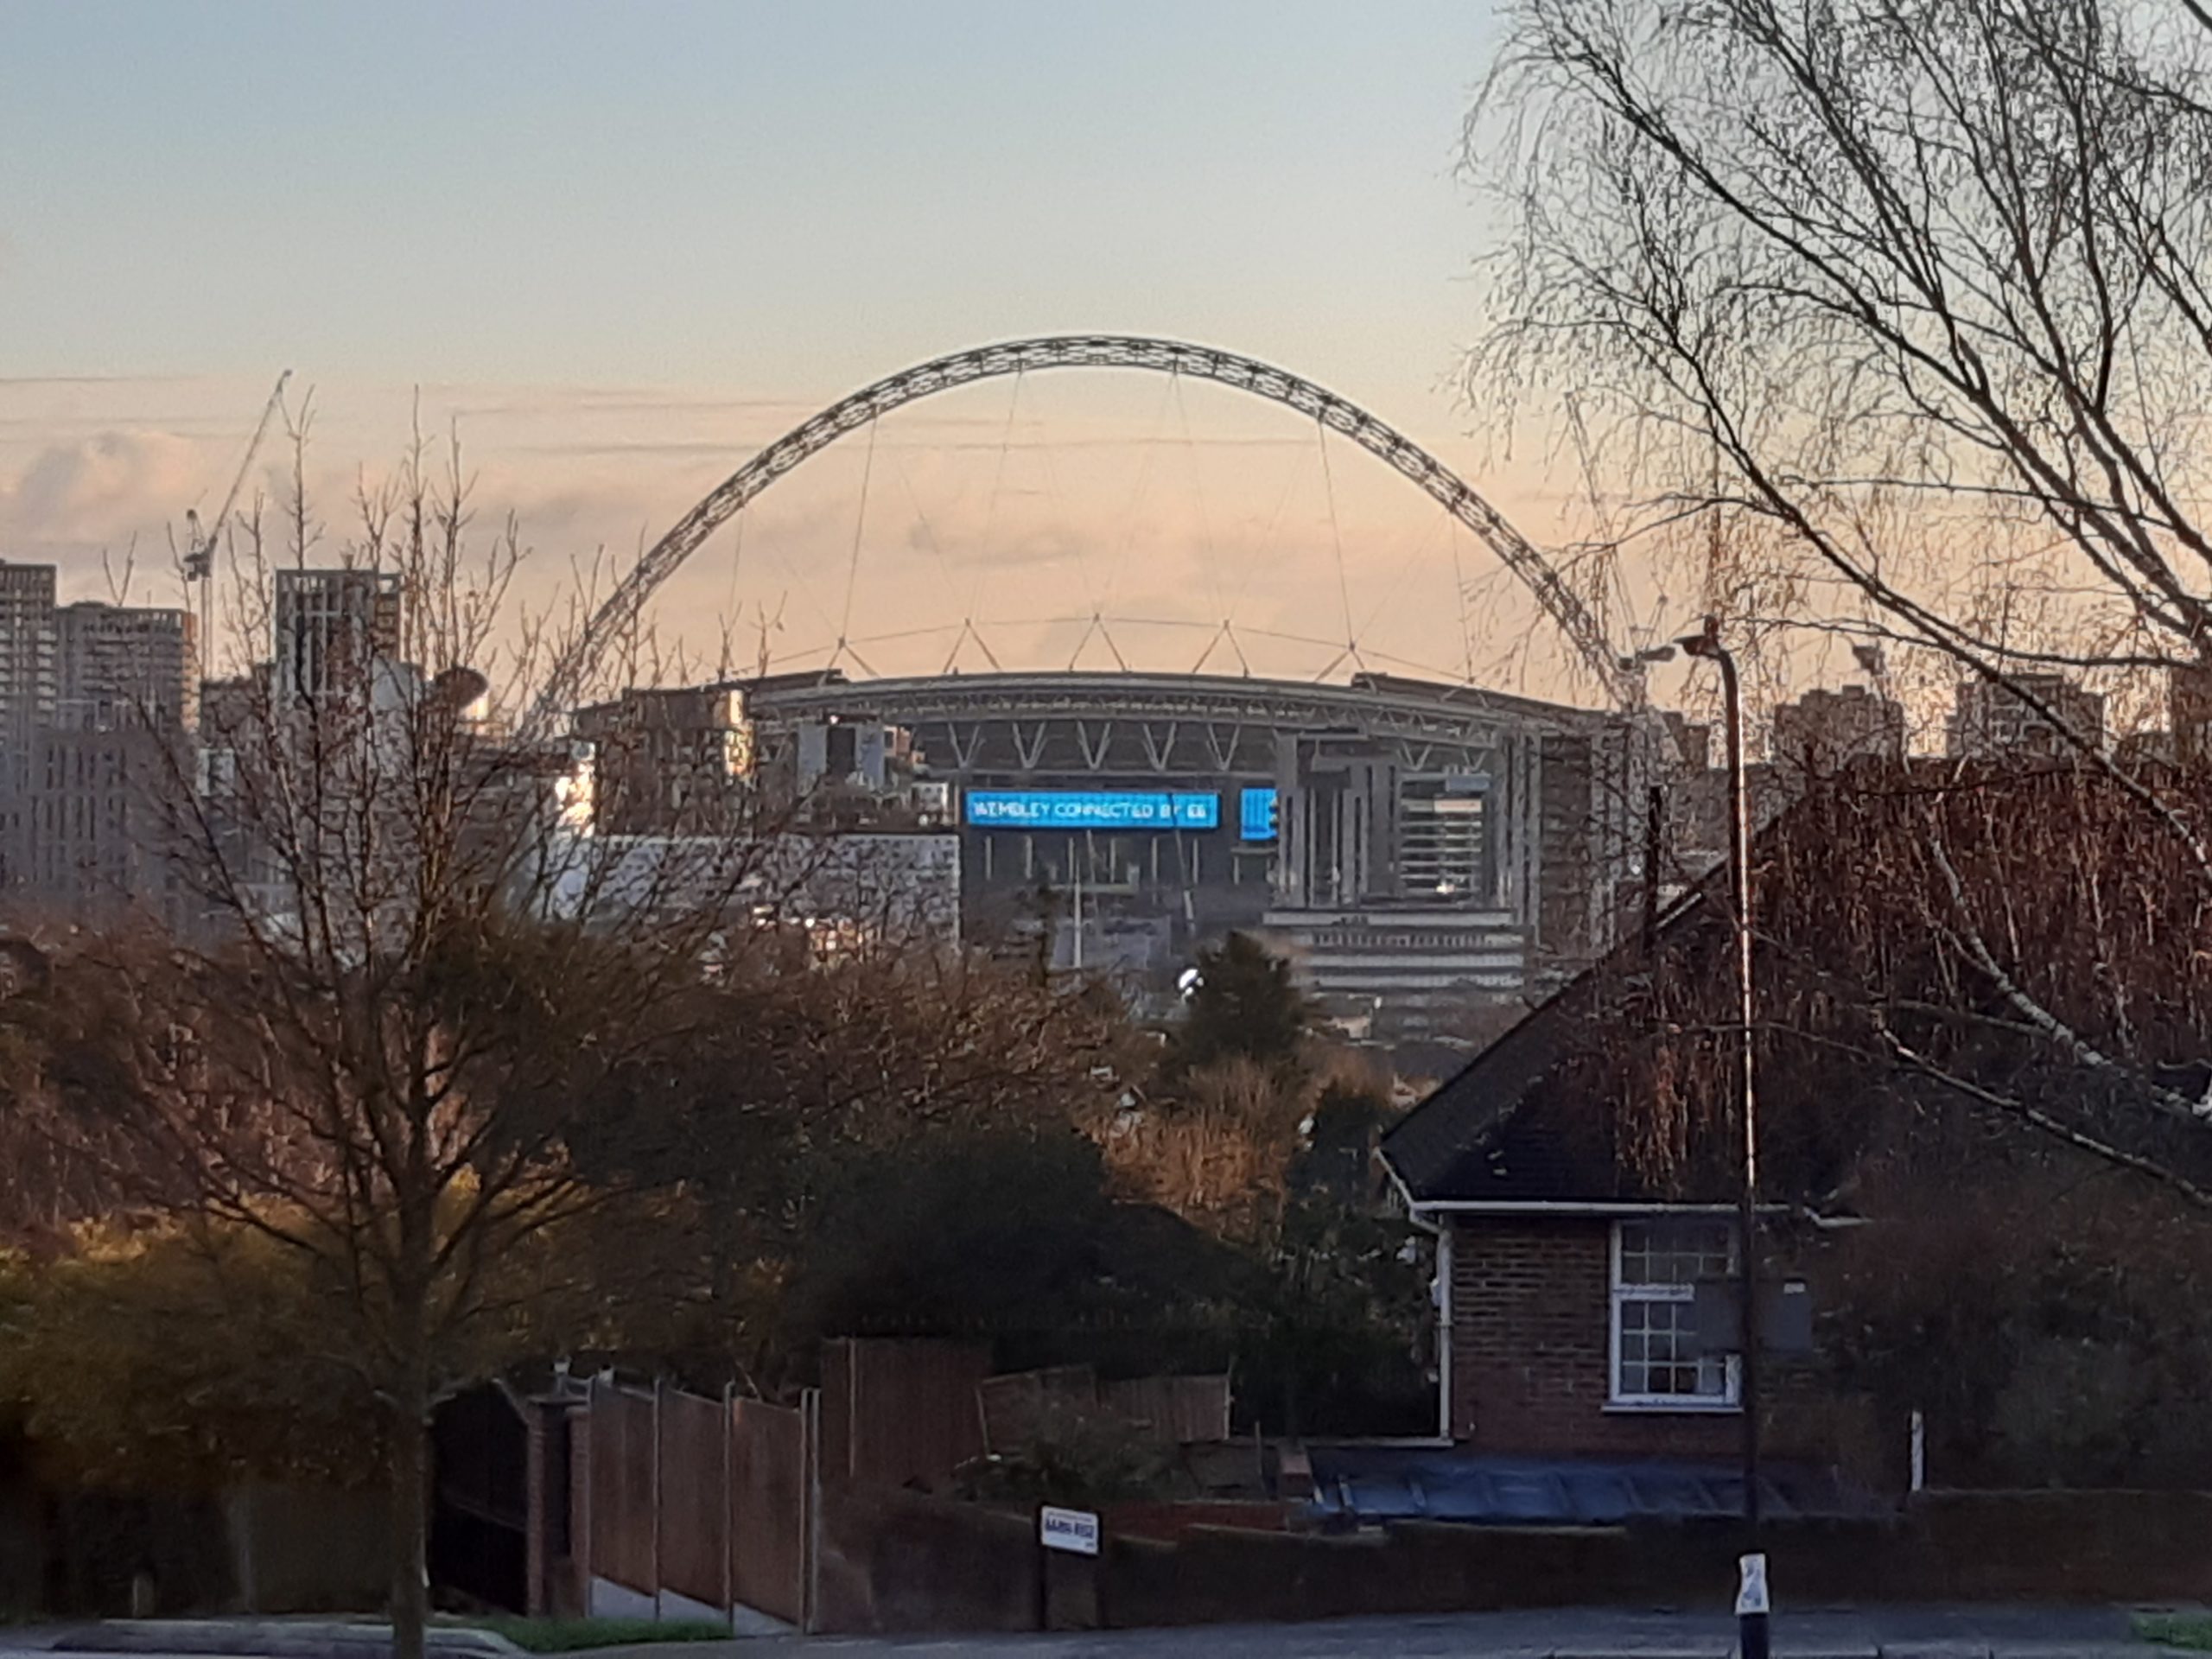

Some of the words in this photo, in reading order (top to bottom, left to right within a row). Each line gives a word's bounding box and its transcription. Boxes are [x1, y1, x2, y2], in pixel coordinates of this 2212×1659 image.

[974, 802, 1050, 818] WEMBLEY
[1054, 803, 1154, 819] CONNECTED
[1160, 804, 1182, 819] BY
